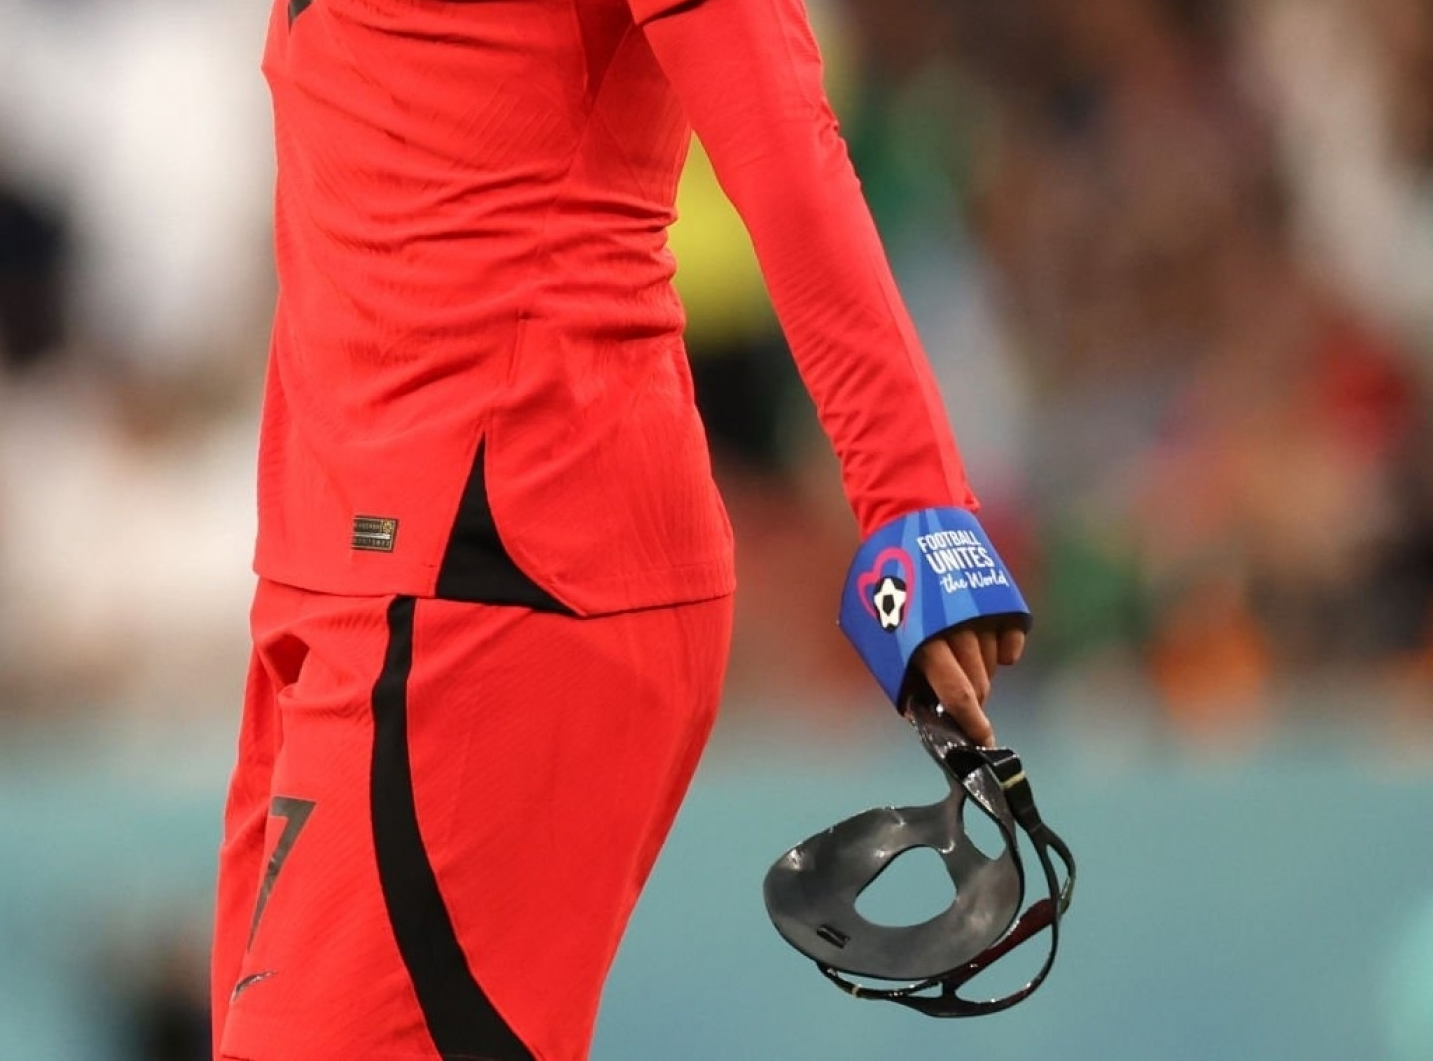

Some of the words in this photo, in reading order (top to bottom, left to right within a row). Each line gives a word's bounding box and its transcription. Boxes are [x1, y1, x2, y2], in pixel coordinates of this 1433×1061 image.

[917, 530, 981, 553] FOOTBALL
[926, 547, 995, 574] UNITES
[940, 573, 968, 593] the
[964, 568, 1009, 588] World
[247, 796, 317, 953] 7
